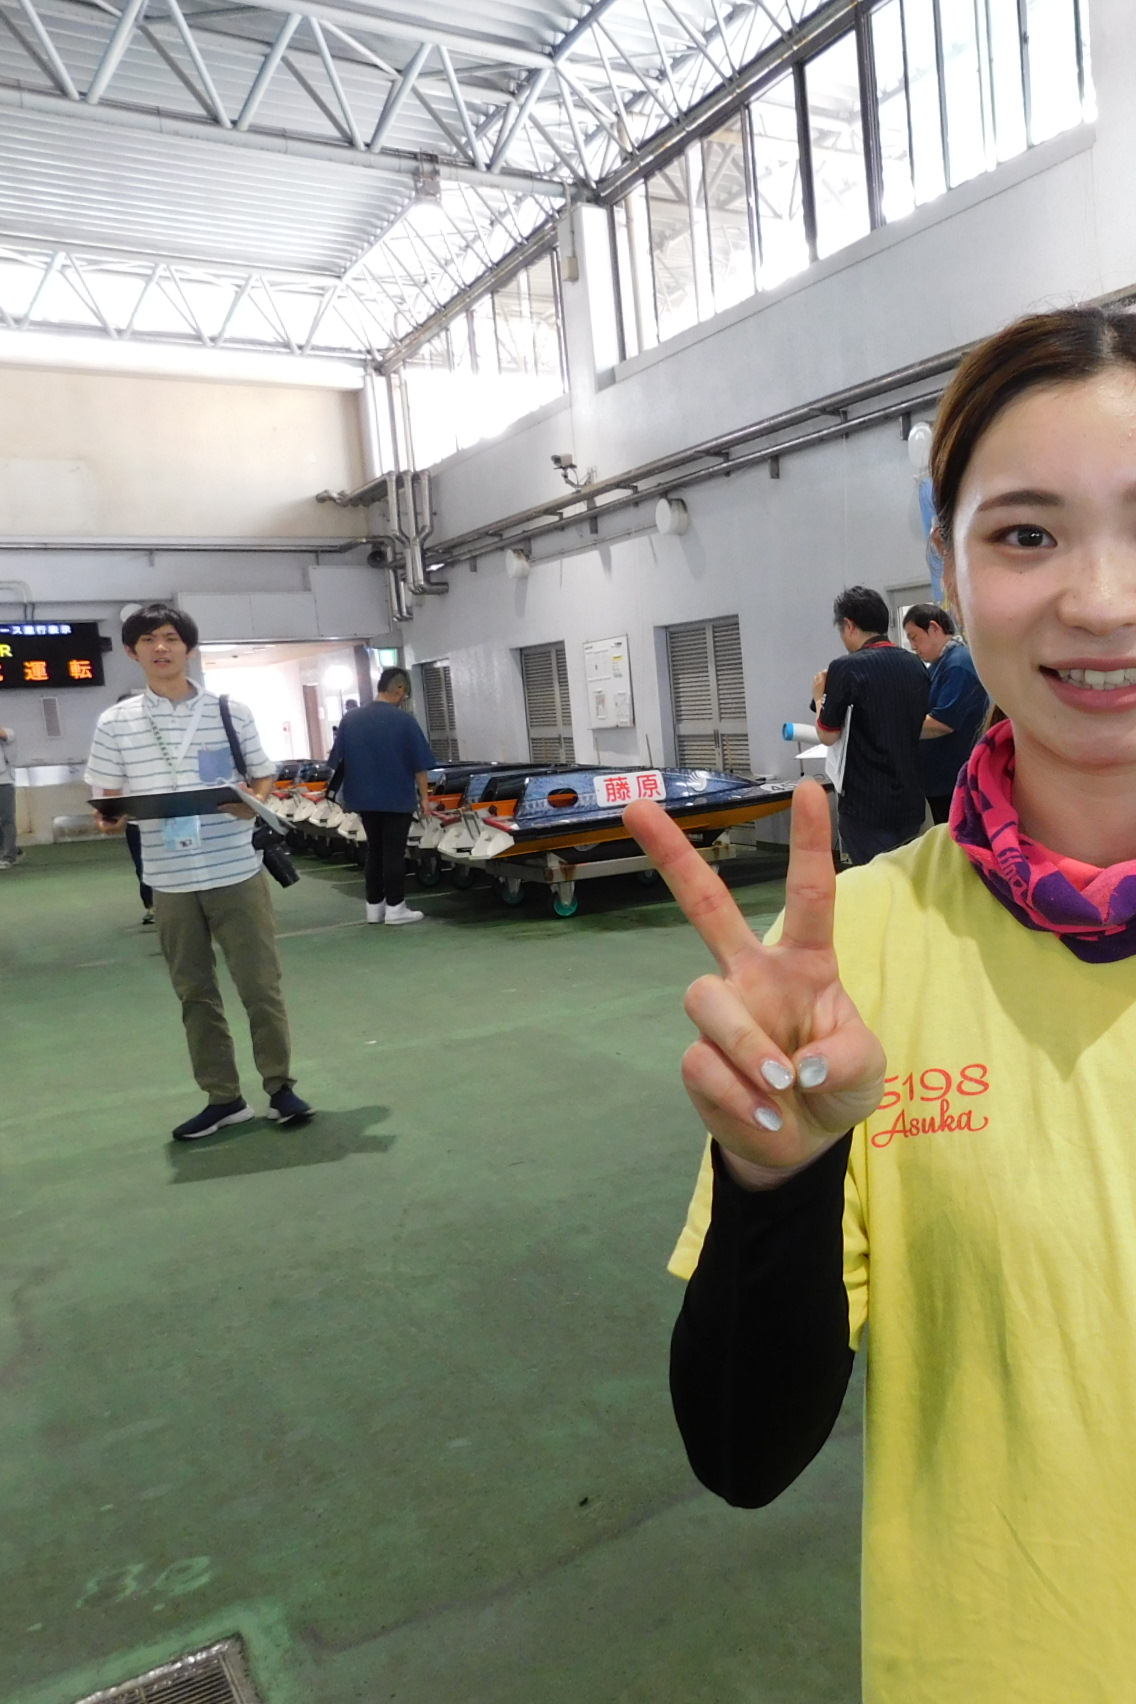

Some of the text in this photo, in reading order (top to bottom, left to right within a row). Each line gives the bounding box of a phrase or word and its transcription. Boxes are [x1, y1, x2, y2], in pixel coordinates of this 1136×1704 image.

[603, 774, 662, 802] 藤原
[877, 1063, 990, 1110] 5198
[871, 1098, 989, 1148] Asuka
